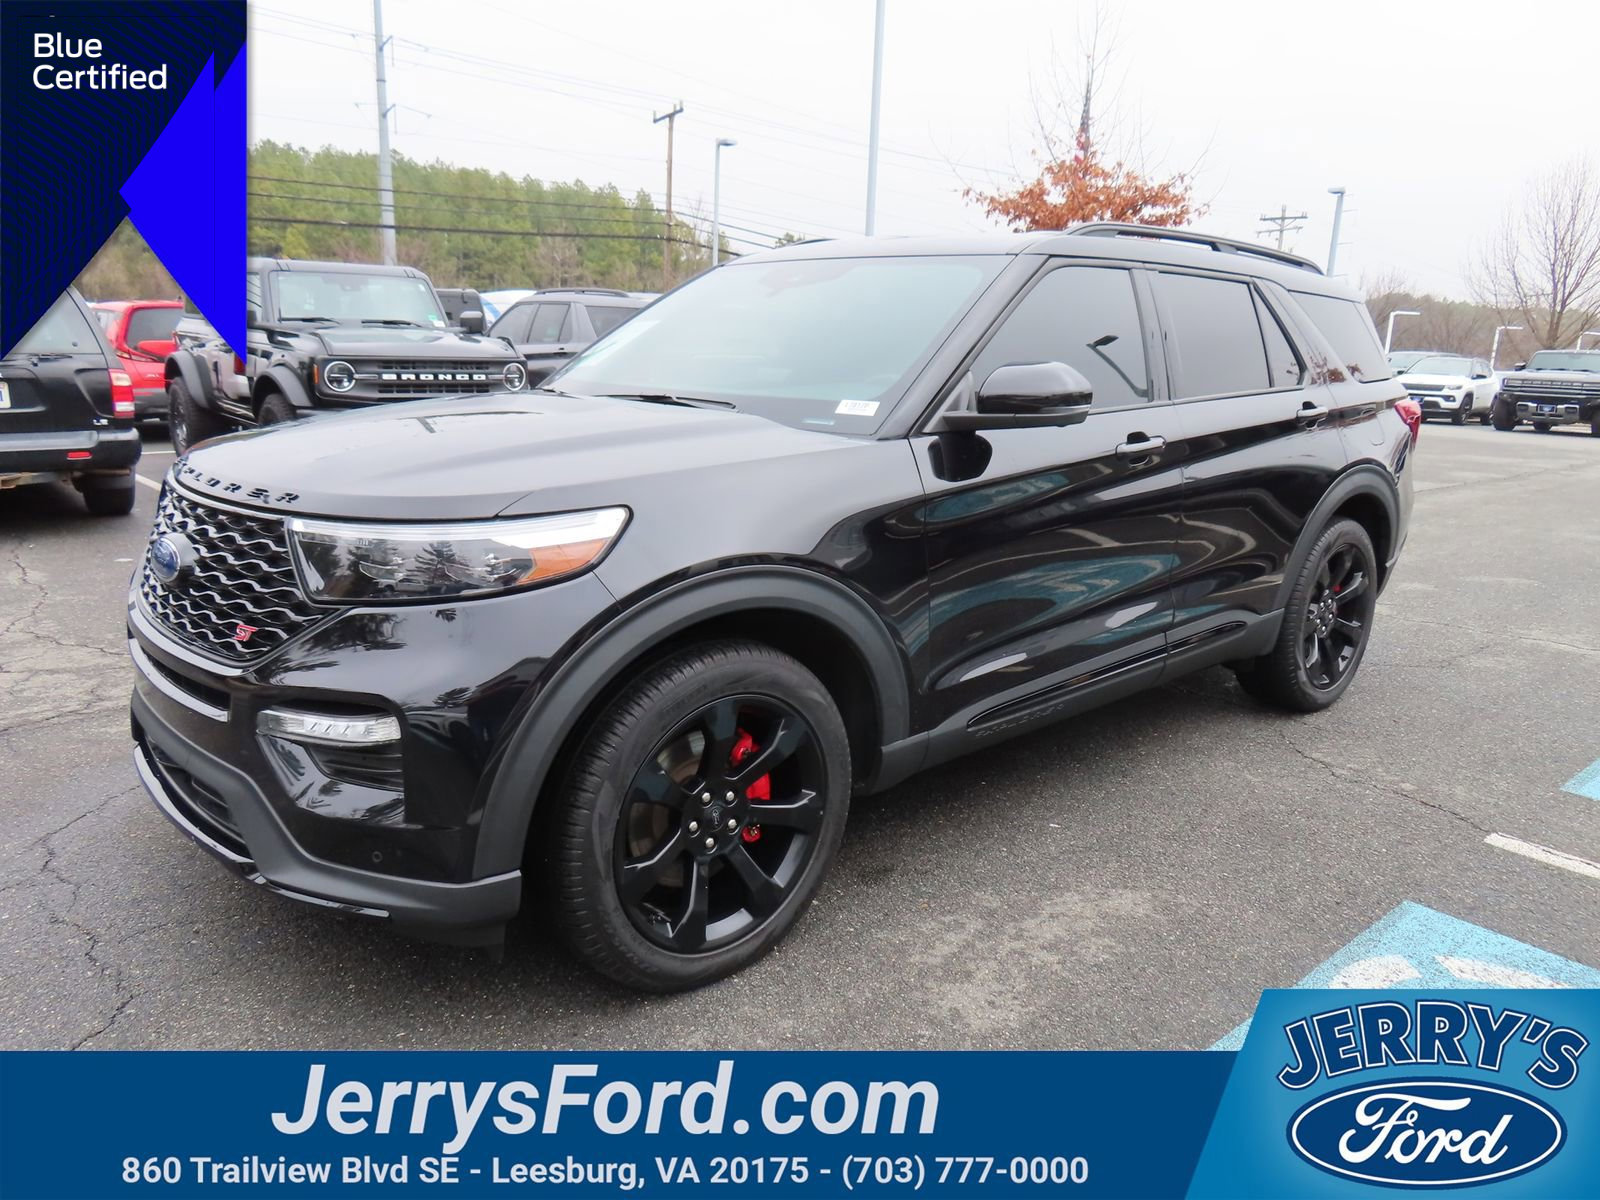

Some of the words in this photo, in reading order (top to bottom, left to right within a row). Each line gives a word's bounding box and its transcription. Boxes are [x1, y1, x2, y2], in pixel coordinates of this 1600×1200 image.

[381, 372, 487, 381] BRONCO
[176, 457, 299, 503] PLORER
[233, 624, 258, 642] ST
